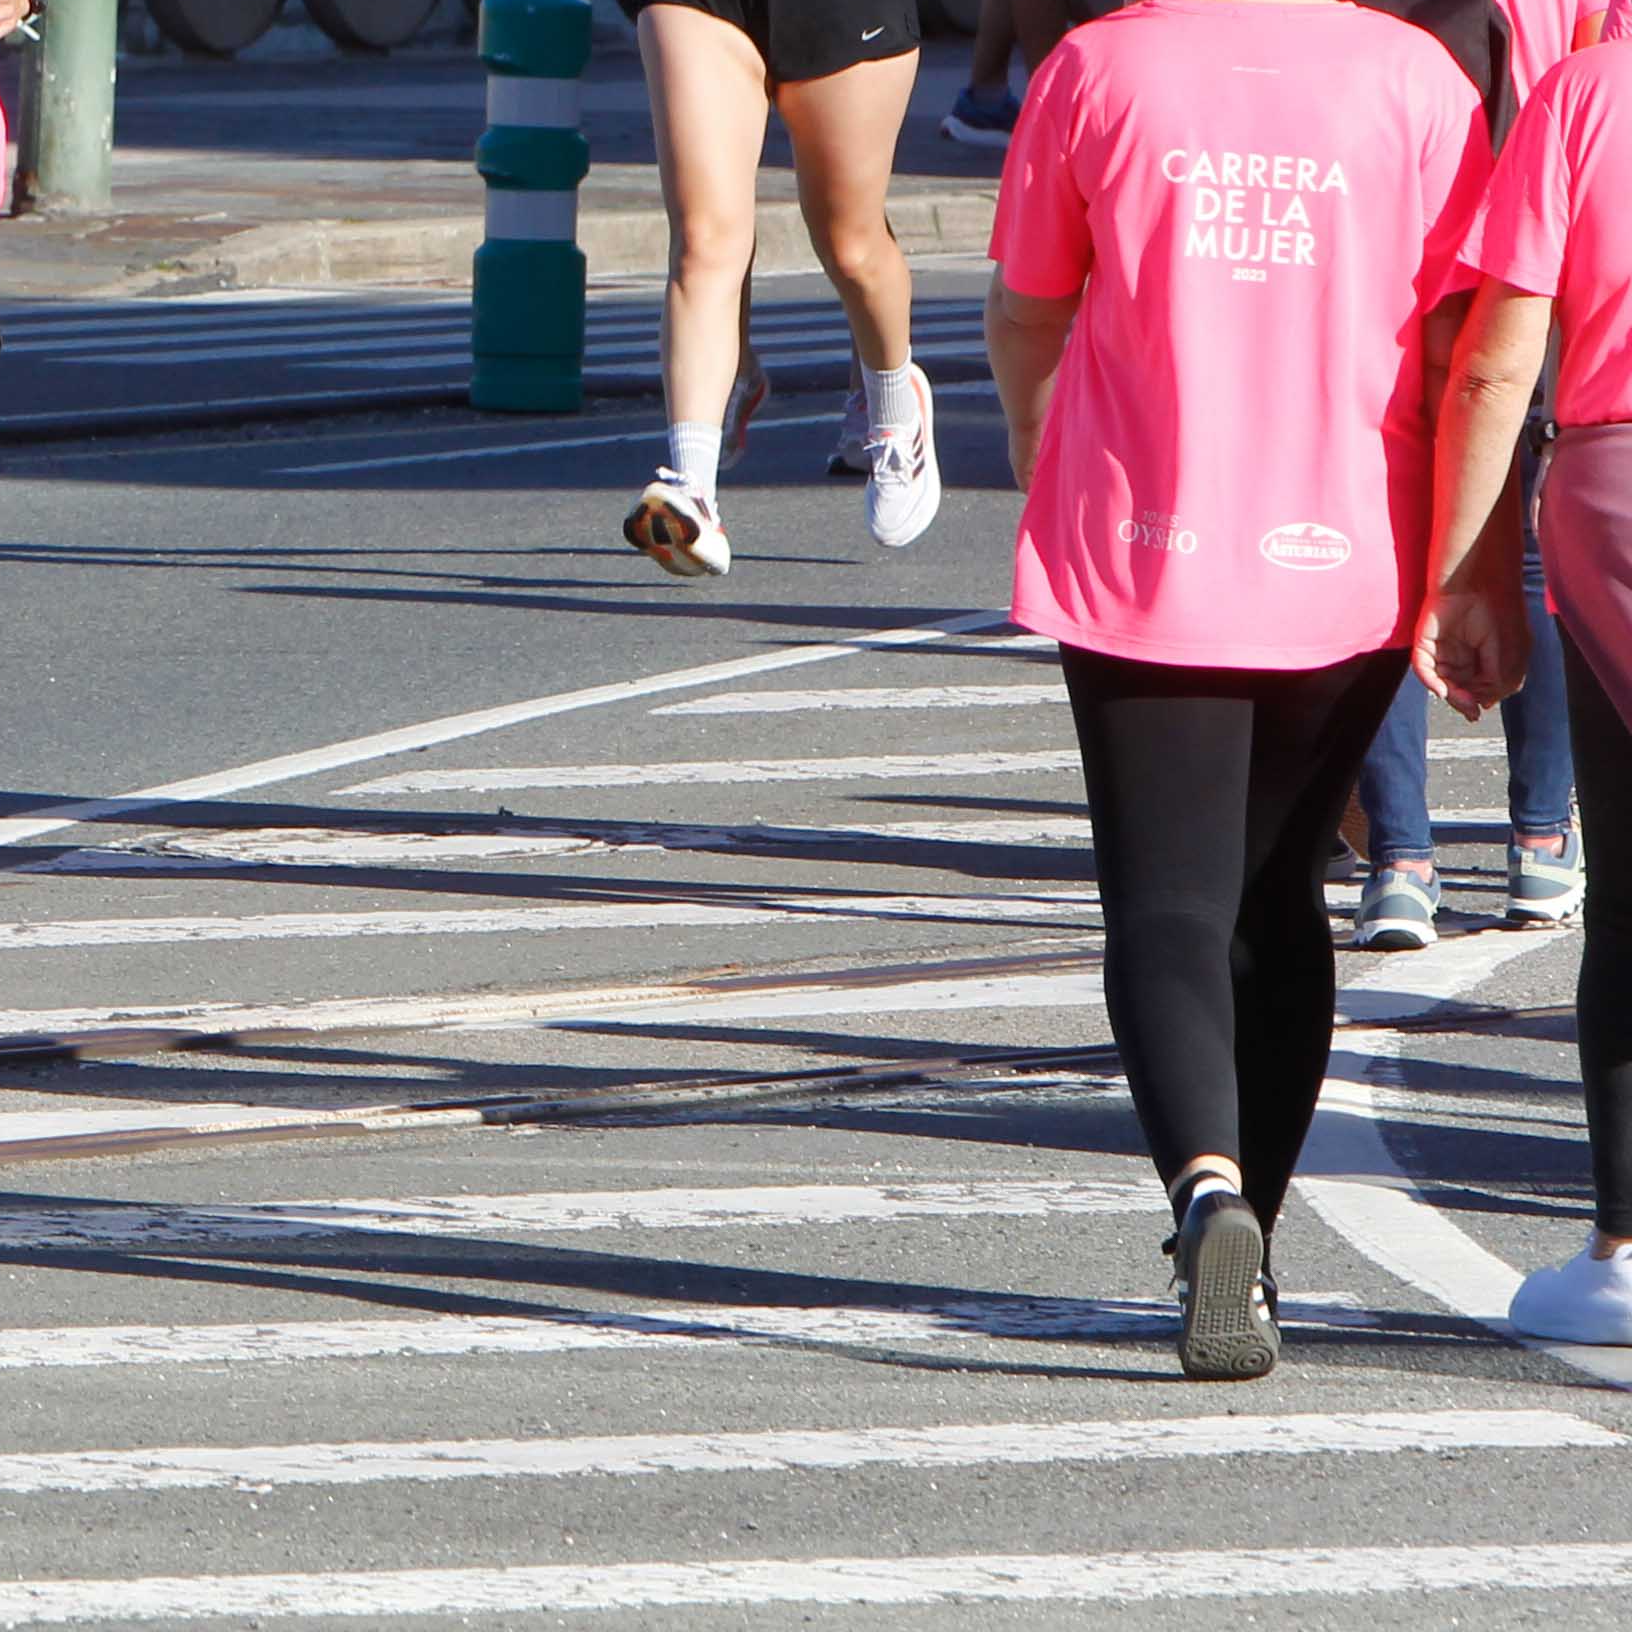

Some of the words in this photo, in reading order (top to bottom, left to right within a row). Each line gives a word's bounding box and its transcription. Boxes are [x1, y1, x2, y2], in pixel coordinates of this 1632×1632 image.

[1161, 149, 1349, 196] CARRERA
[1194, 186, 1246, 224] DE
[1262, 191, 1311, 229] LA
[1184, 222, 1317, 266] MUJER
[1232, 267, 1267, 282] 2023
[1118, 519, 1198, 555] OYSHO
